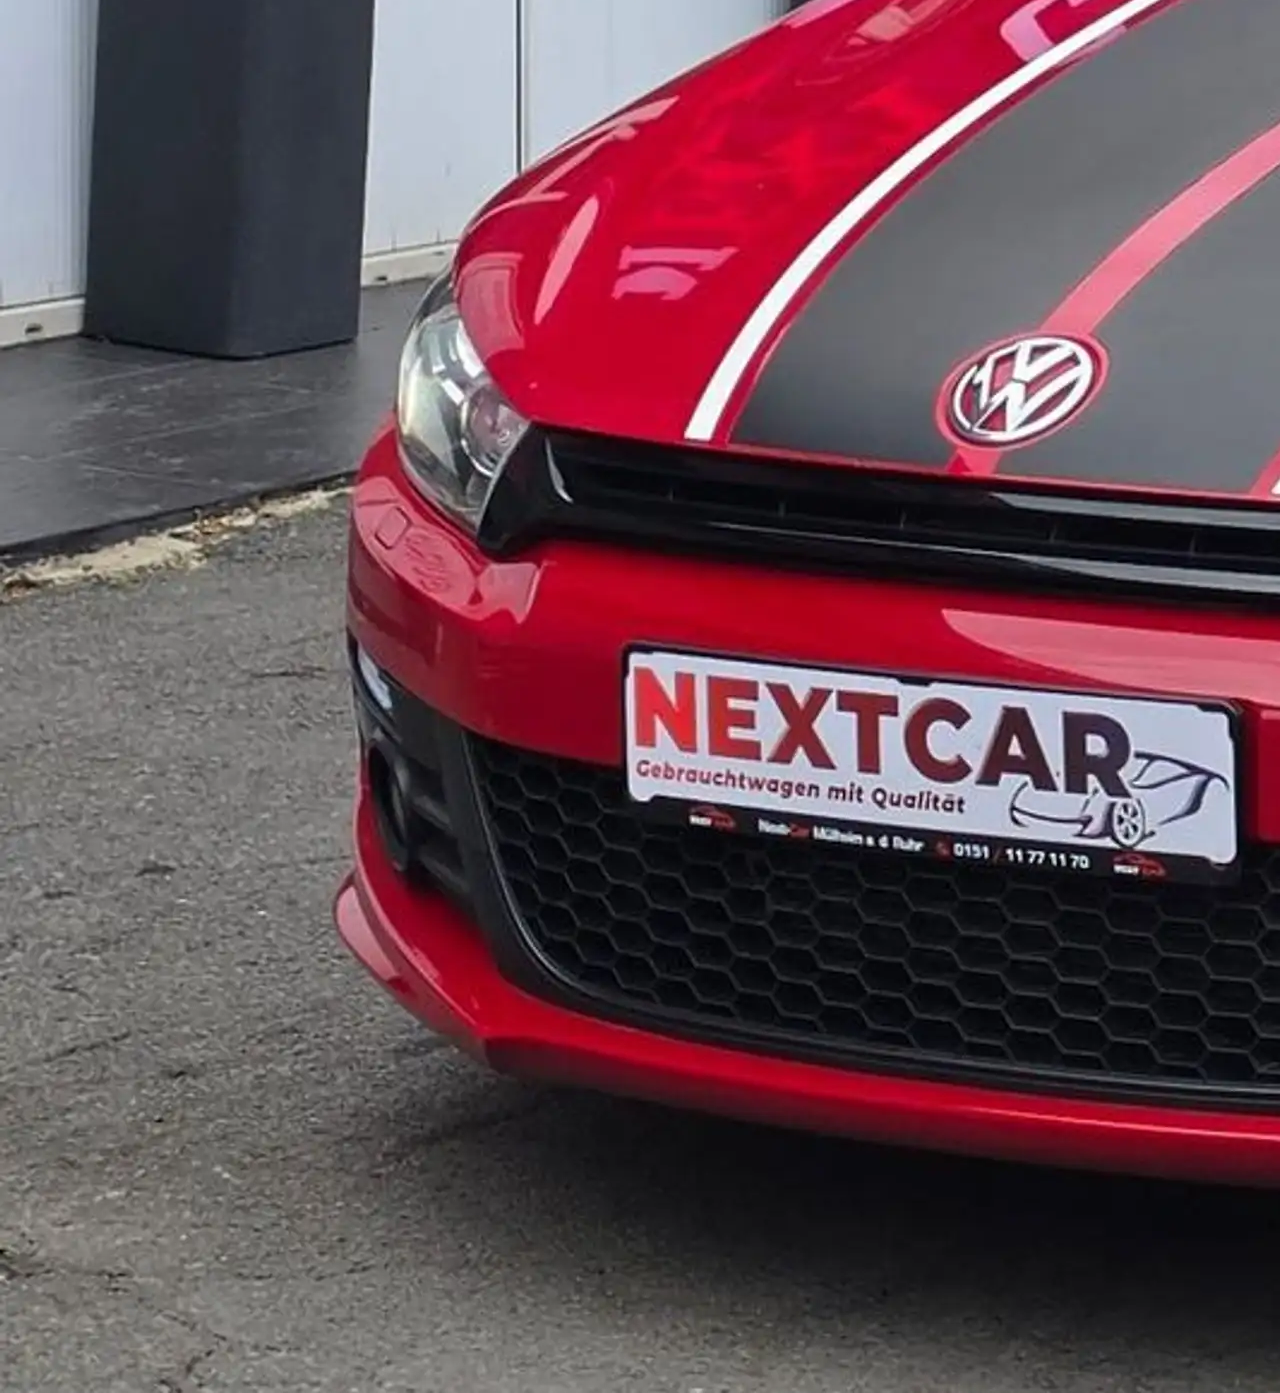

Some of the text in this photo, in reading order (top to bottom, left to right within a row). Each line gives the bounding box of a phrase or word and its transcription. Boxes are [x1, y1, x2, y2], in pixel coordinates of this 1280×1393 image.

[952, 336, 1093, 443] VW
[632, 666, 1134, 798] NEXTCAR
[635, 760, 965, 814] Gebrauchtwagen mit Qualität
